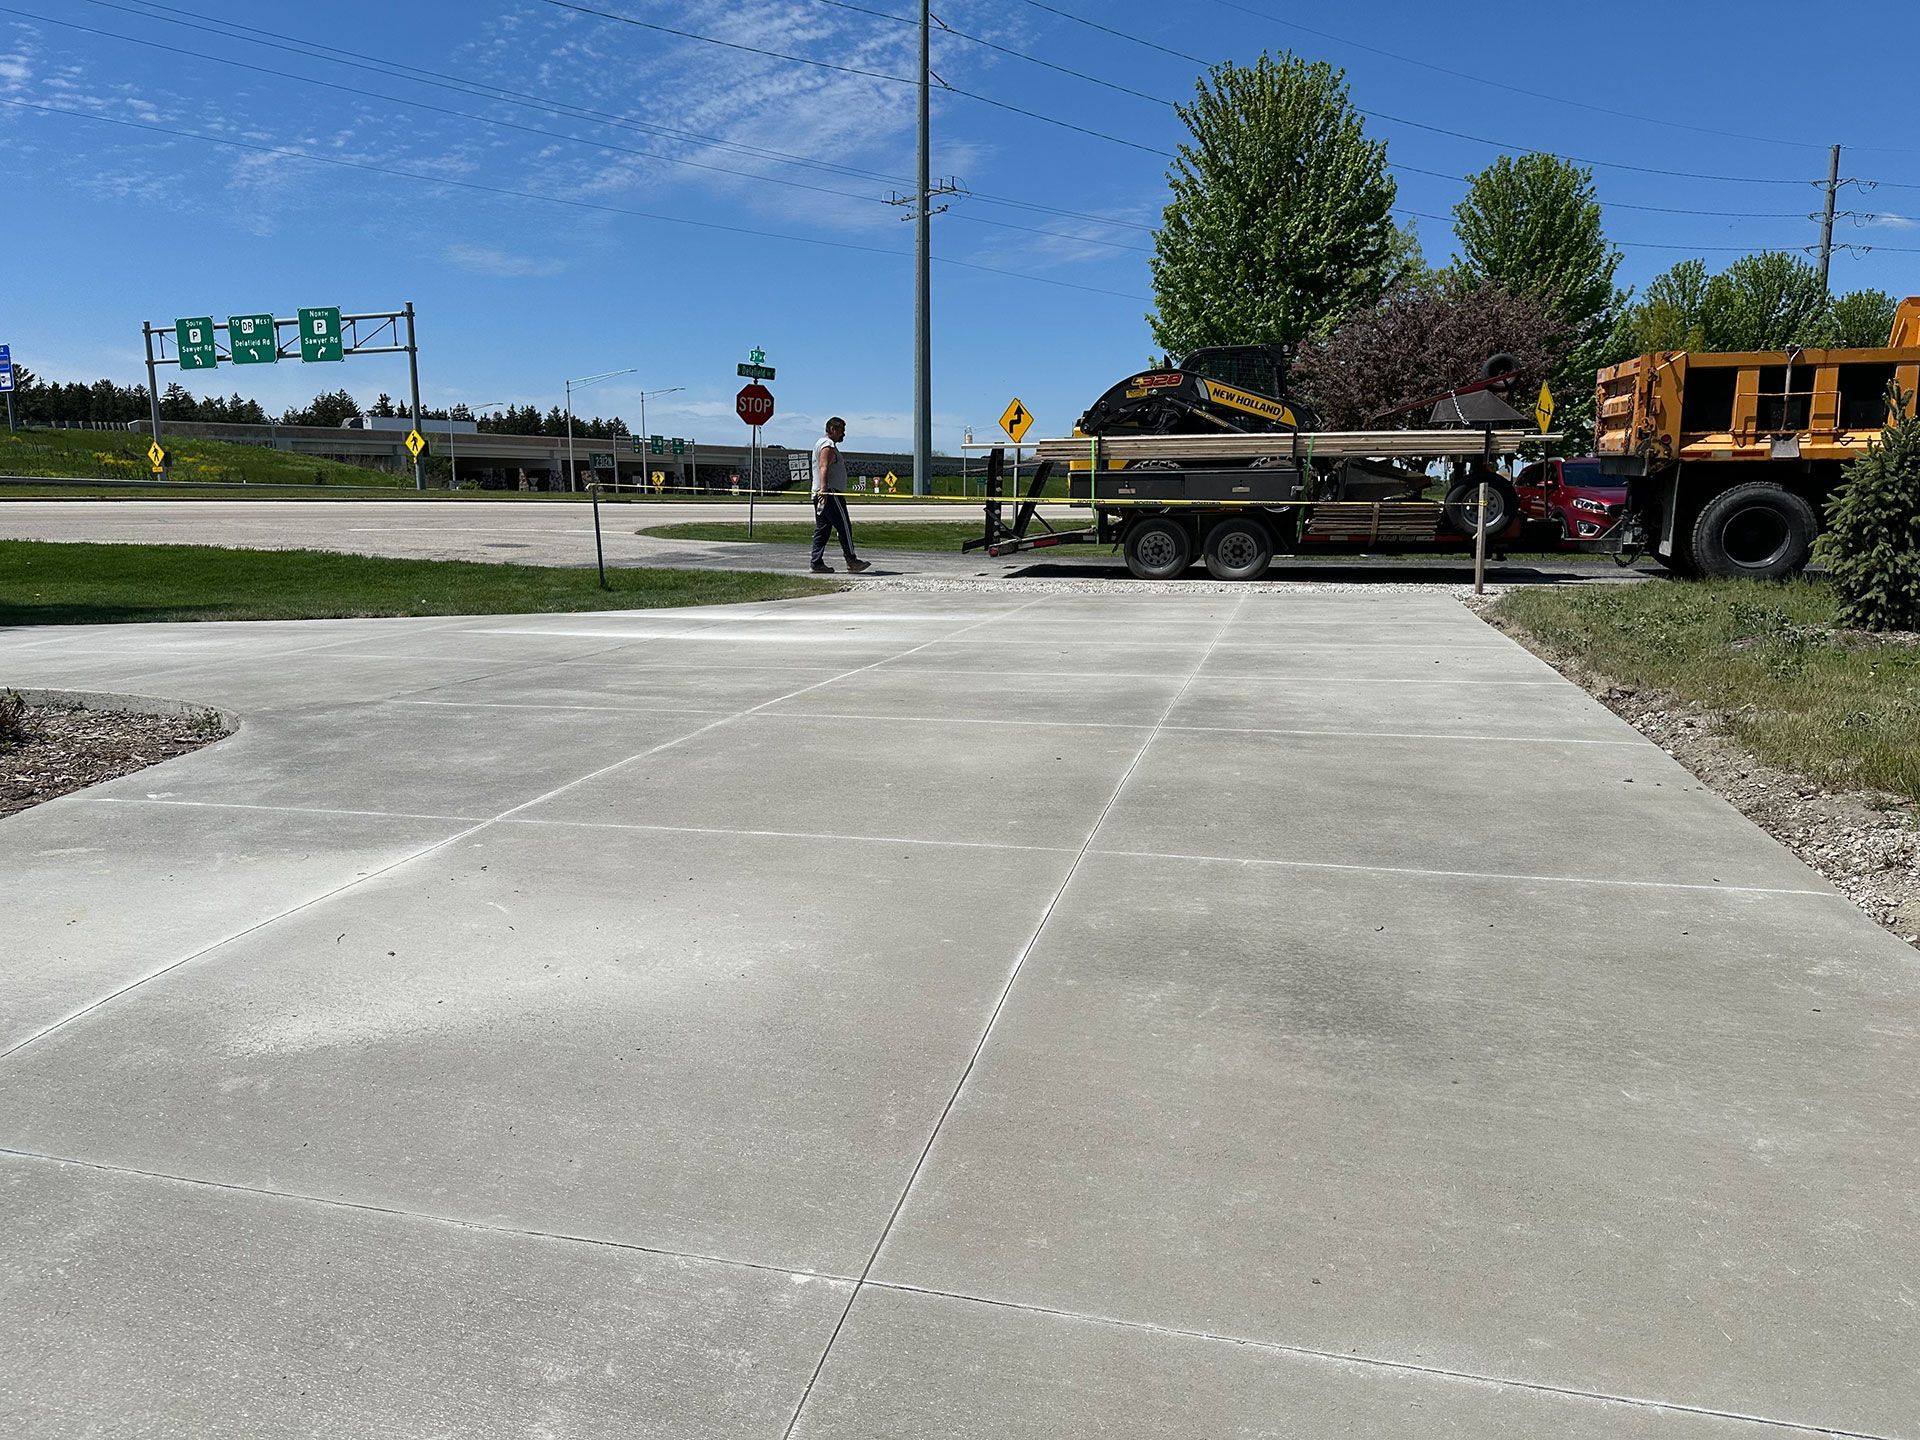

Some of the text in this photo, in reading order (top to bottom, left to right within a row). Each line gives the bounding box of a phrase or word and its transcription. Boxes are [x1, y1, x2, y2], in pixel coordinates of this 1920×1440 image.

[309, 310, 328, 318] NORTH
[242, 322, 253, 331] DR
[317, 322, 323, 331] P
[192, 331, 198, 340] P
[235, 339, 261, 347] Delafield
[304, 337, 327, 345] Sawyer
[182, 345, 202, 353] Sawyer
[739, 397, 771, 413] STOP
[1212, 387, 1281, 415] NEW HOLLAND
